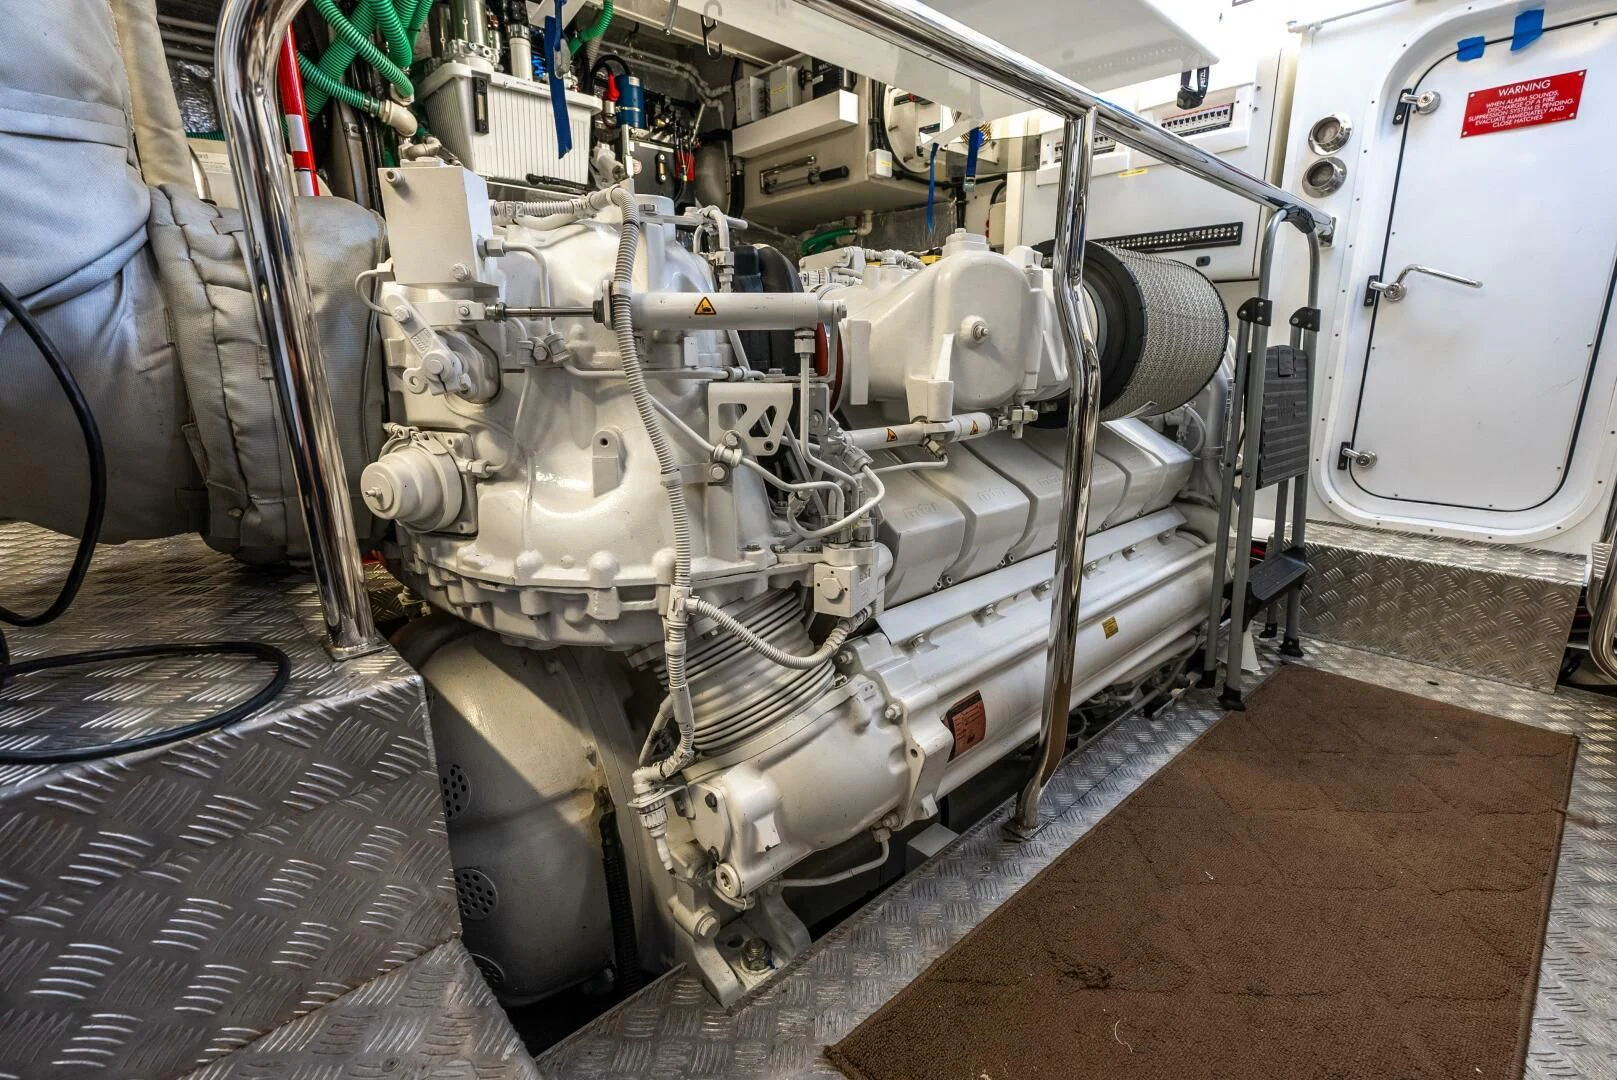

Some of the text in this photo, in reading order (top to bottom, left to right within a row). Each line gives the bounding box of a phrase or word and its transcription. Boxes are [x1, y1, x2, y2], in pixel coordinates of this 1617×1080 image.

[1498, 79, 1551, 97] WARNING
[1486, 99, 1506, 109] WHEN
[1506, 95, 1528, 104] ALARM
[1488, 102, 1524, 114] DISCHARGE
[1542, 95, 1556, 104] FIRE
[1468, 110, 1508, 122] SUPPRESSION
[1509, 105, 1533, 115] SYSTEM
[1475, 115, 1506, 126] EVACUATE
[1506, 108, 1548, 120] IMMEDIATELY
[1548, 105, 1565, 113] AND
[1492, 119, 1512, 128] CLOSE
[1513, 115, 1544, 125] HATCHES
